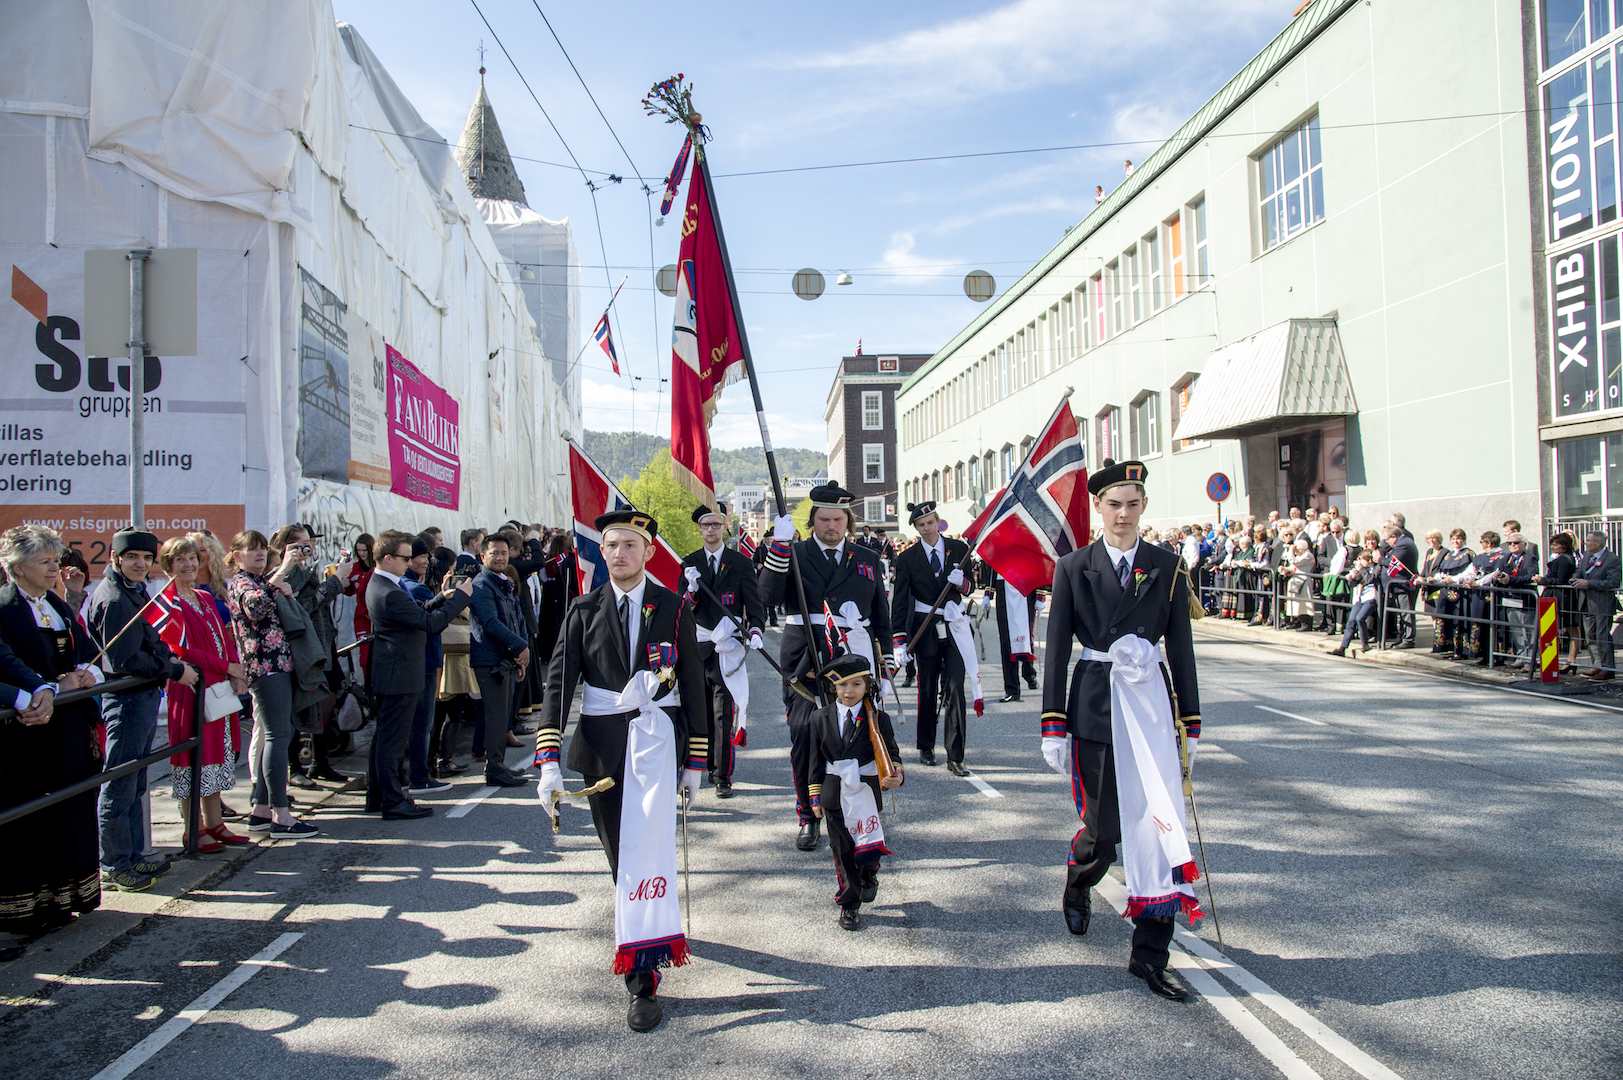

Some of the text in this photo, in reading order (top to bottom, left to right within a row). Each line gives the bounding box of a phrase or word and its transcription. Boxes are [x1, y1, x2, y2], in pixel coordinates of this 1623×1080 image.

[1549, 113, 1588, 373] XHIBTION
[0, 424, 44, 441] illas
[0, 449, 192, 471] verflatebehadling
[22, 516, 207, 534] www.stsgrupen.com
[850, 815, 879, 835] MB
[629, 876, 667, 901] MB
